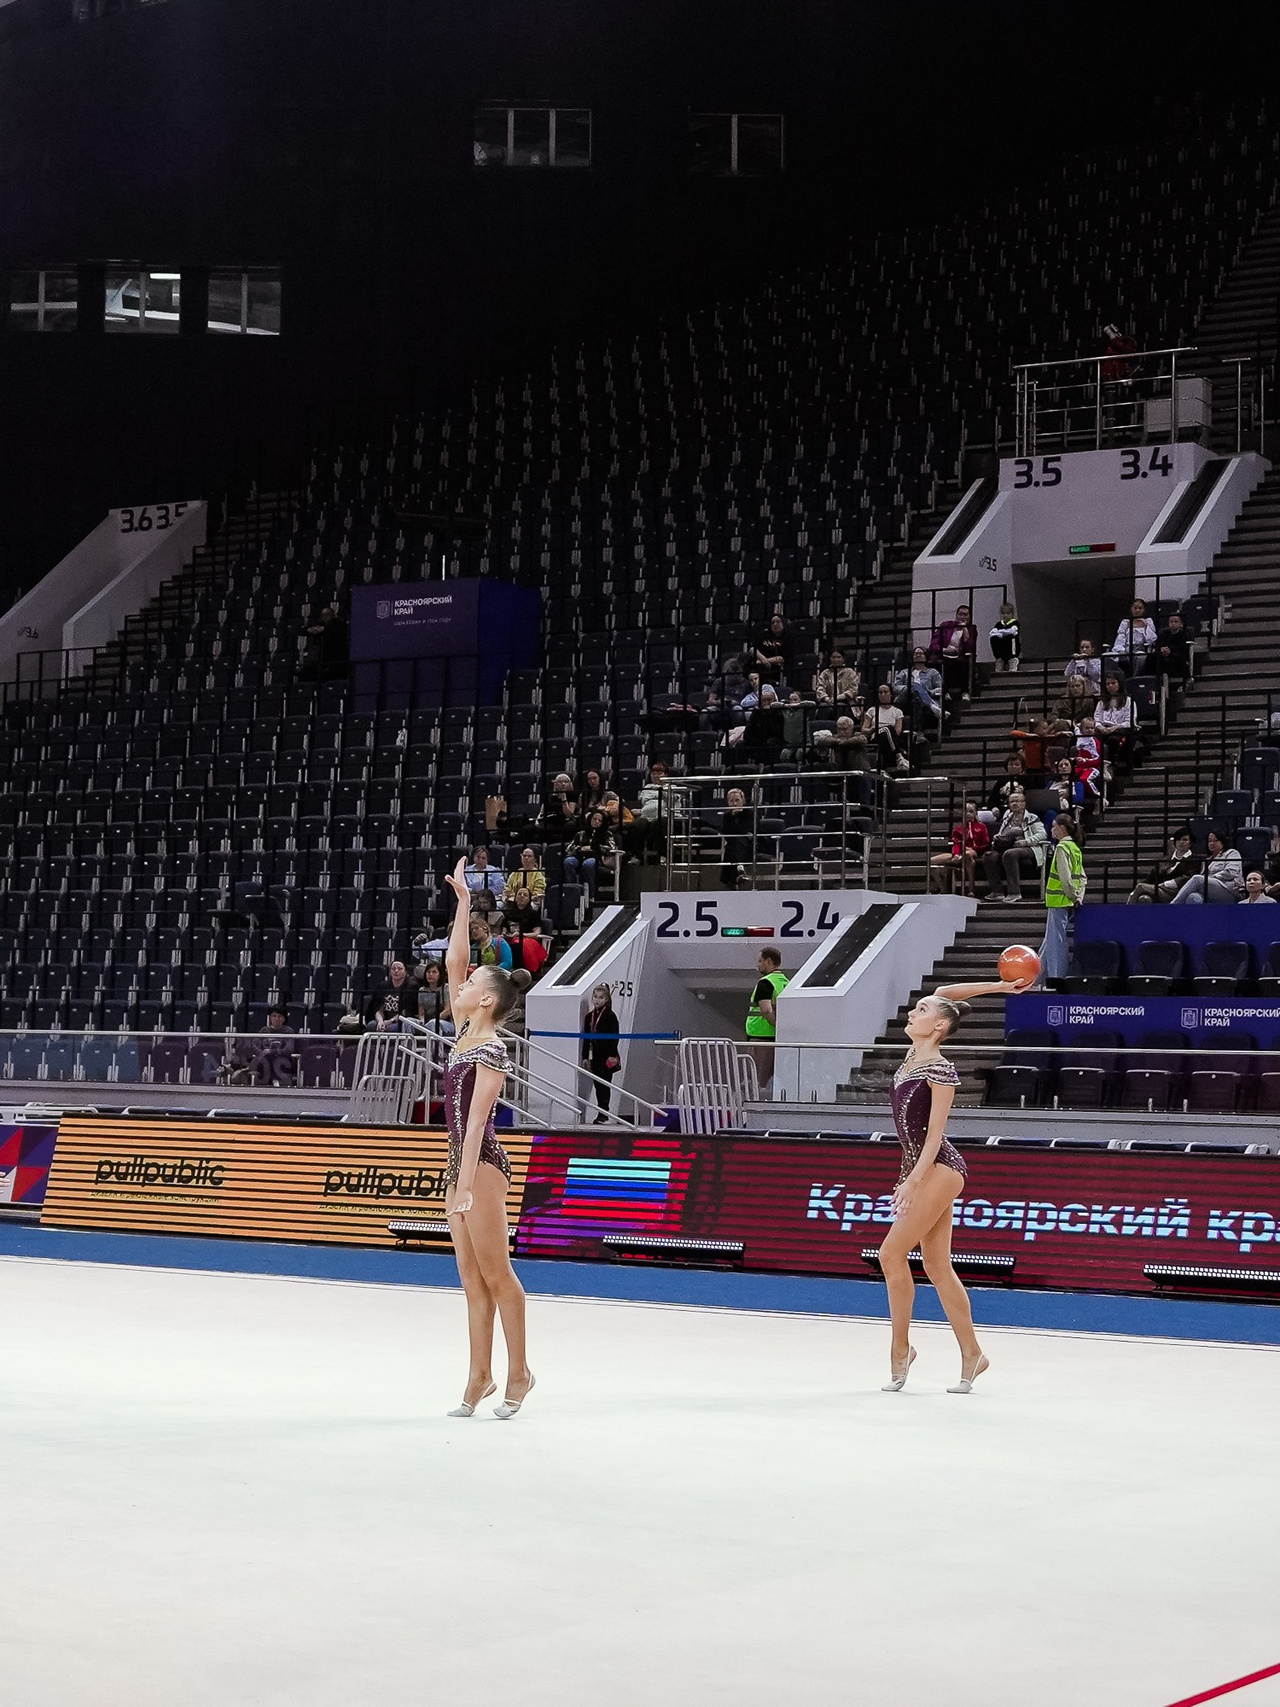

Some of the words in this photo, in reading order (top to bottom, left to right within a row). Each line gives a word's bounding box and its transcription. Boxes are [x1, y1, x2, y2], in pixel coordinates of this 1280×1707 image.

[1014, 456, 1062, 489] 3.5
[1120, 447, 1174, 480] 3.4
[121, 507, 153, 533] 3.6
[394, 595, 453, 607] КРАСНОЯРСКИЙ
[394, 607, 414, 615] КРАЙ
[657, 900, 719, 938] 2.5
[780, 900, 840, 938] 2.4
[1069, 1006, 1145, 1016] КРАСНОЯРСКИЙ
[1069, 1015, 1095, 1025] КРАЙ
[1204, 1016, 1230, 1027] КРАЙ
[94, 1156, 226, 1188] pullpublic
[807, 1183, 1191, 1241] Краоярский
